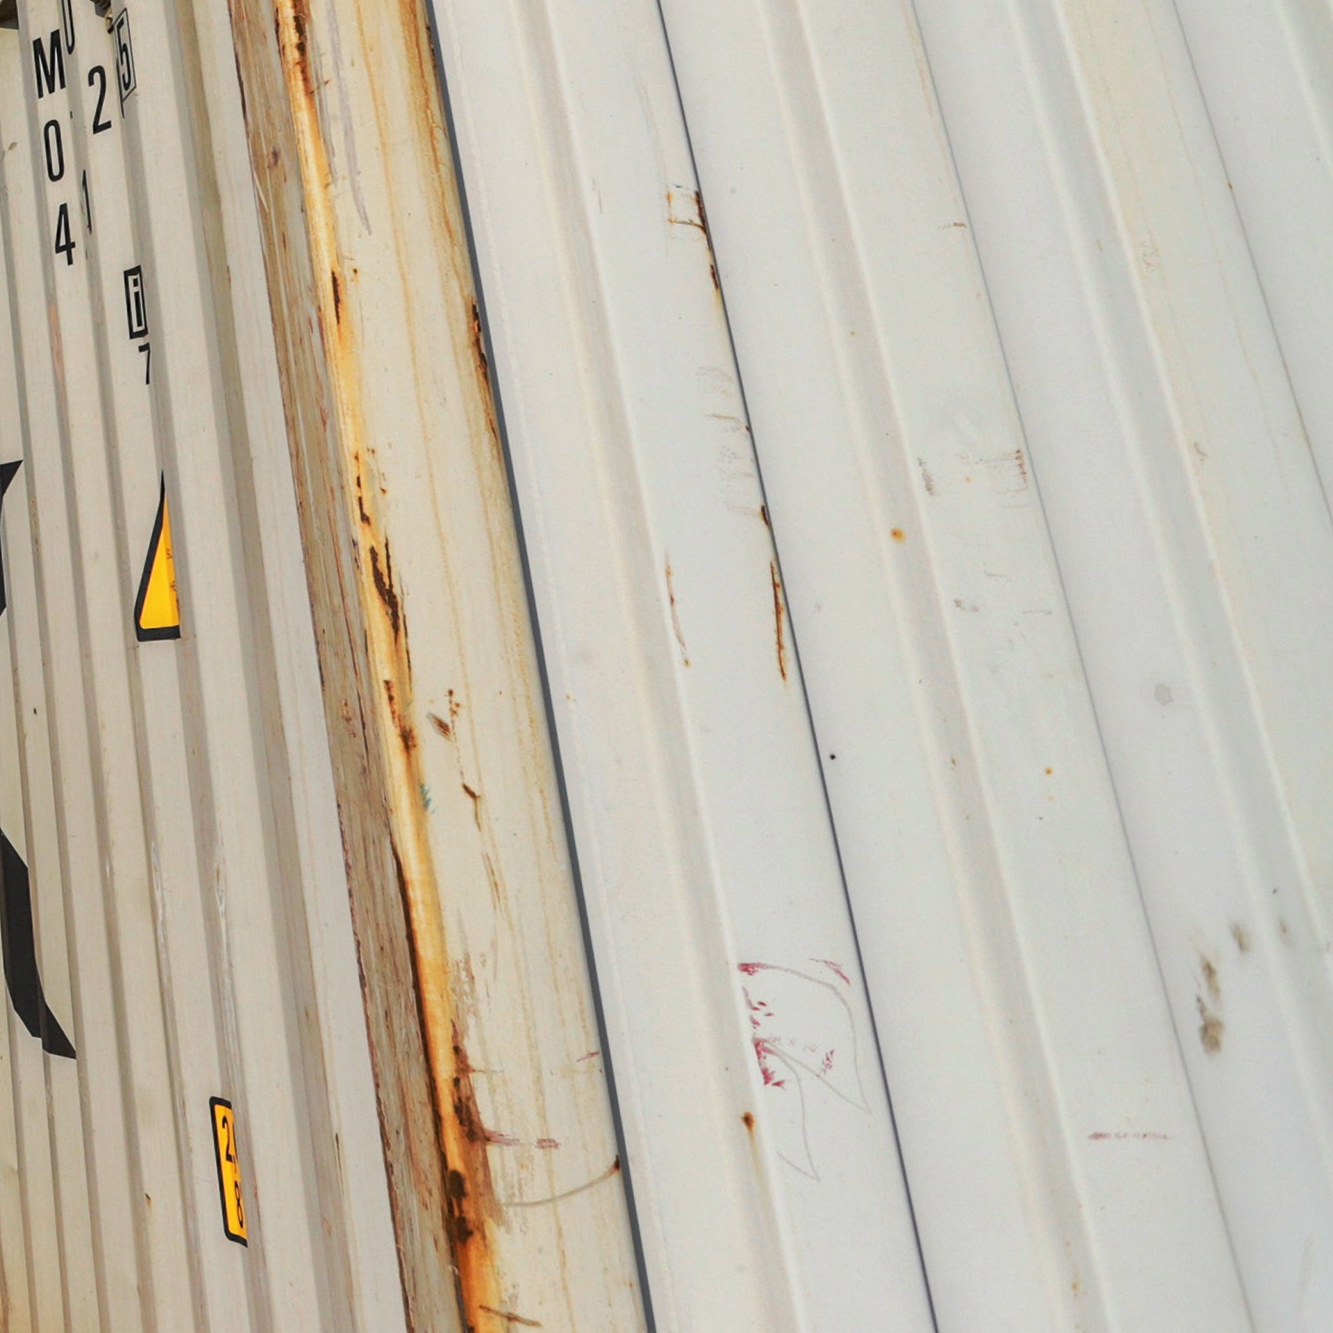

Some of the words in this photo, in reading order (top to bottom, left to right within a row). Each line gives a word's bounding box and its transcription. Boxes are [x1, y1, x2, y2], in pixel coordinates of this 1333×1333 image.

[33, 28, 66, 98] M
[88, 66, 112, 134] 2
[55, 203, 75, 266] 4
